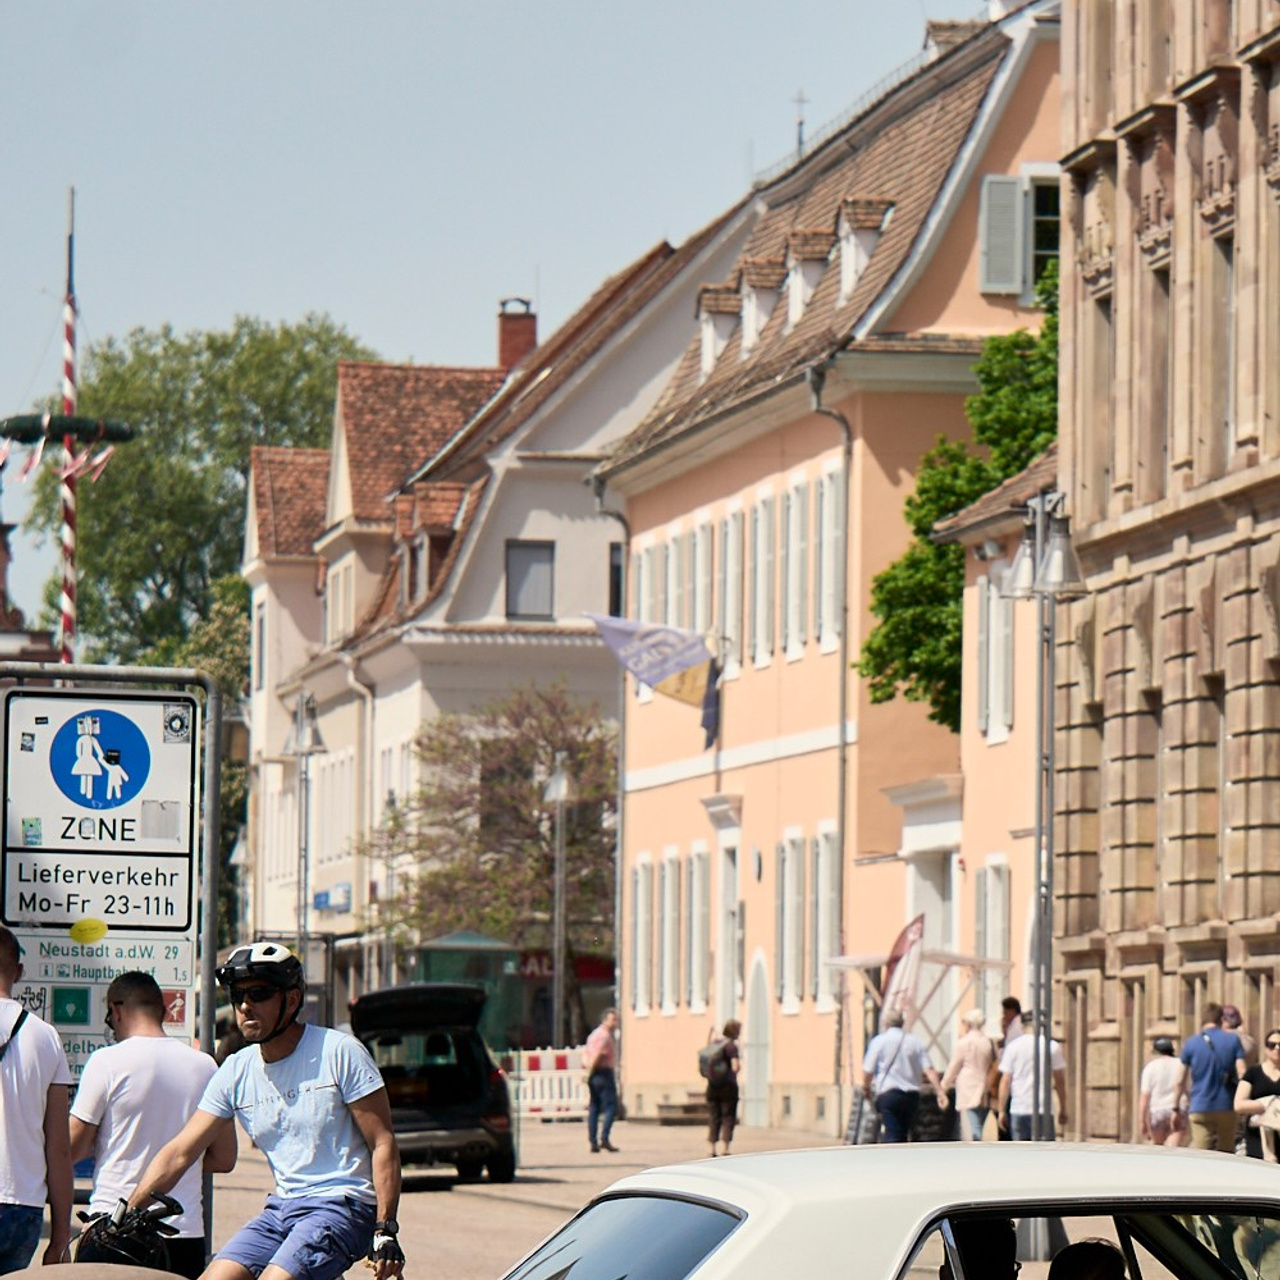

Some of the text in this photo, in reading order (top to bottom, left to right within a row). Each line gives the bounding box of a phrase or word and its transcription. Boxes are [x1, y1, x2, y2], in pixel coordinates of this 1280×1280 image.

[18, 862, 179, 887] Lieferverkehr
[18, 892, 91, 914] Mo-Fr
[39, 942, 110, 958] Neustadt
[164, 946, 179, 960] 29
